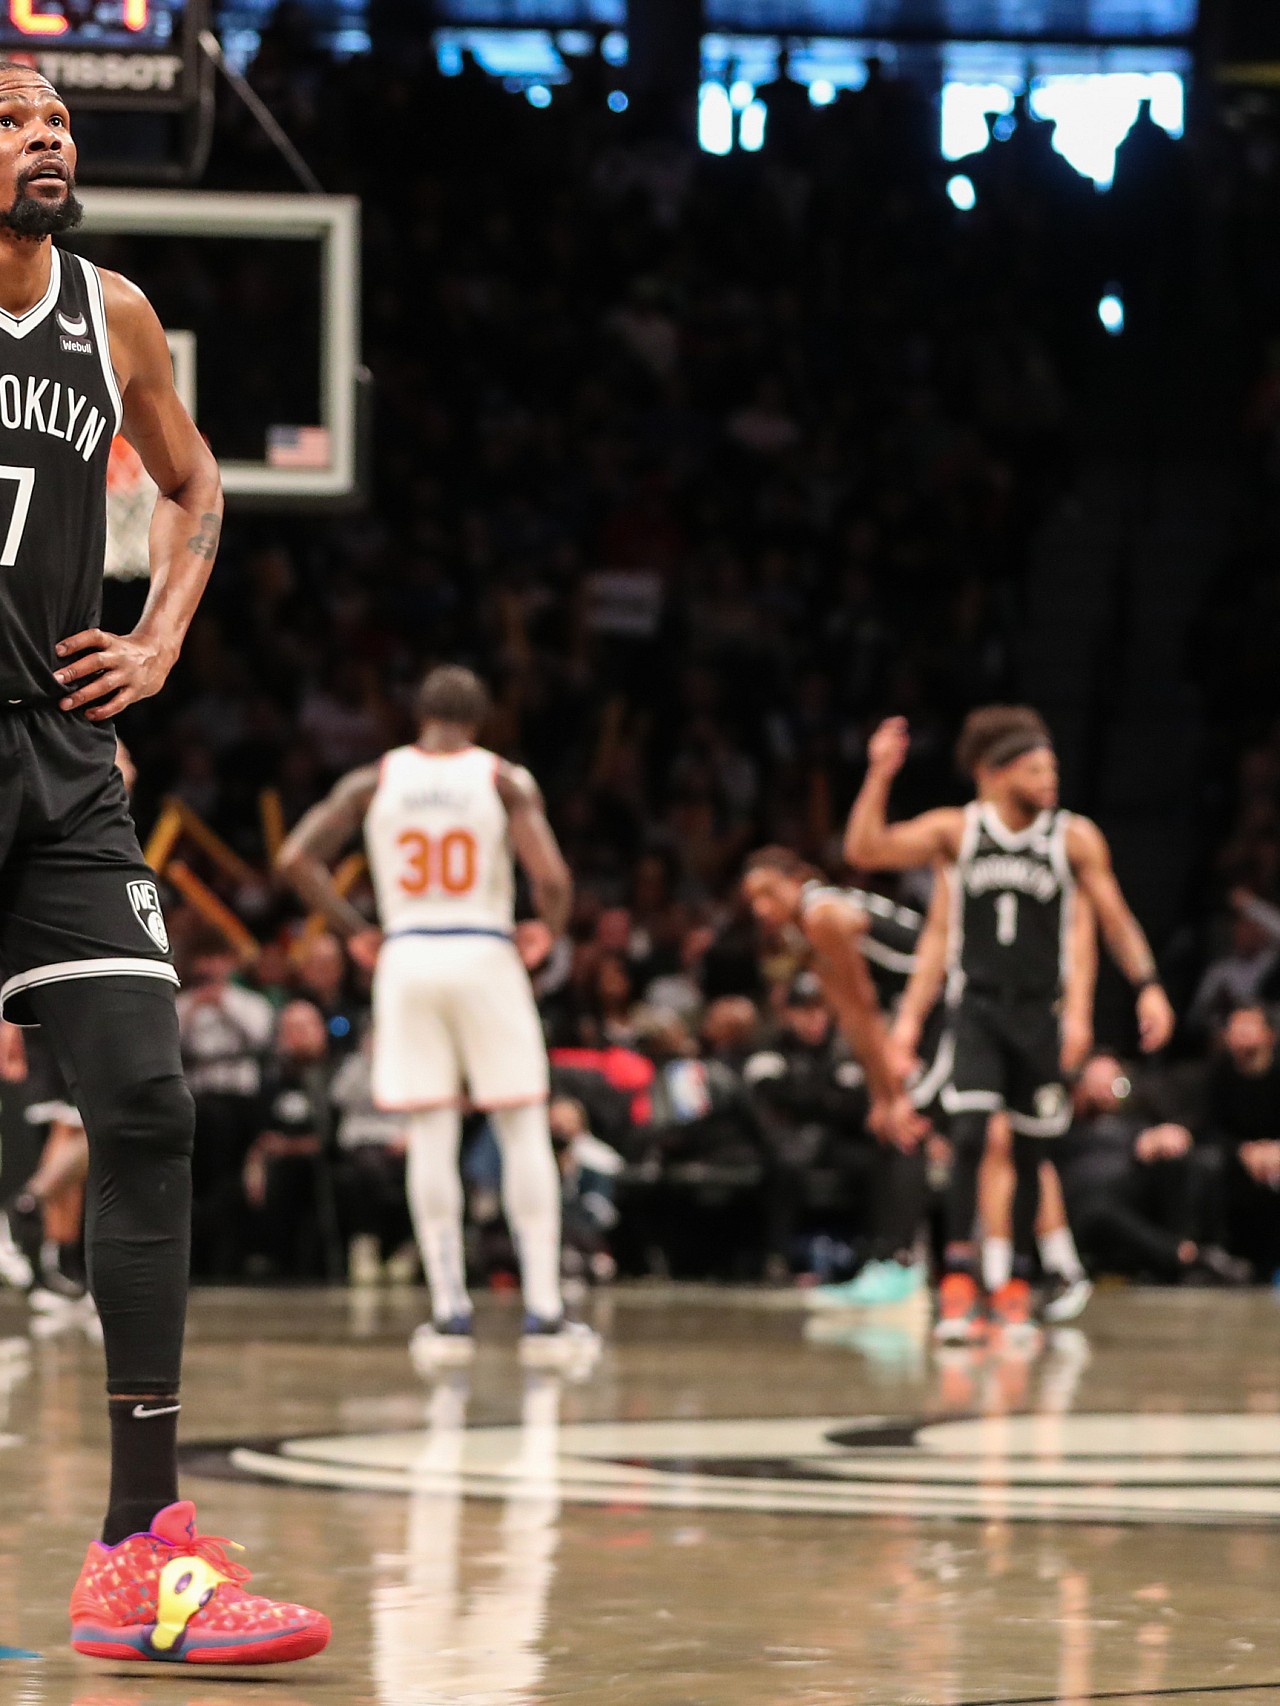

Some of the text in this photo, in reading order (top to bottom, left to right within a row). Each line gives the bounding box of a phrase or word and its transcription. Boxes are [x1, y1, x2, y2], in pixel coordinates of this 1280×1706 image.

[37, 52, 183, 91] TISSOT
[62, 339, 92, 354] Webull
[396, 828, 478, 897] 30
[994, 891, 1018, 947] 1
